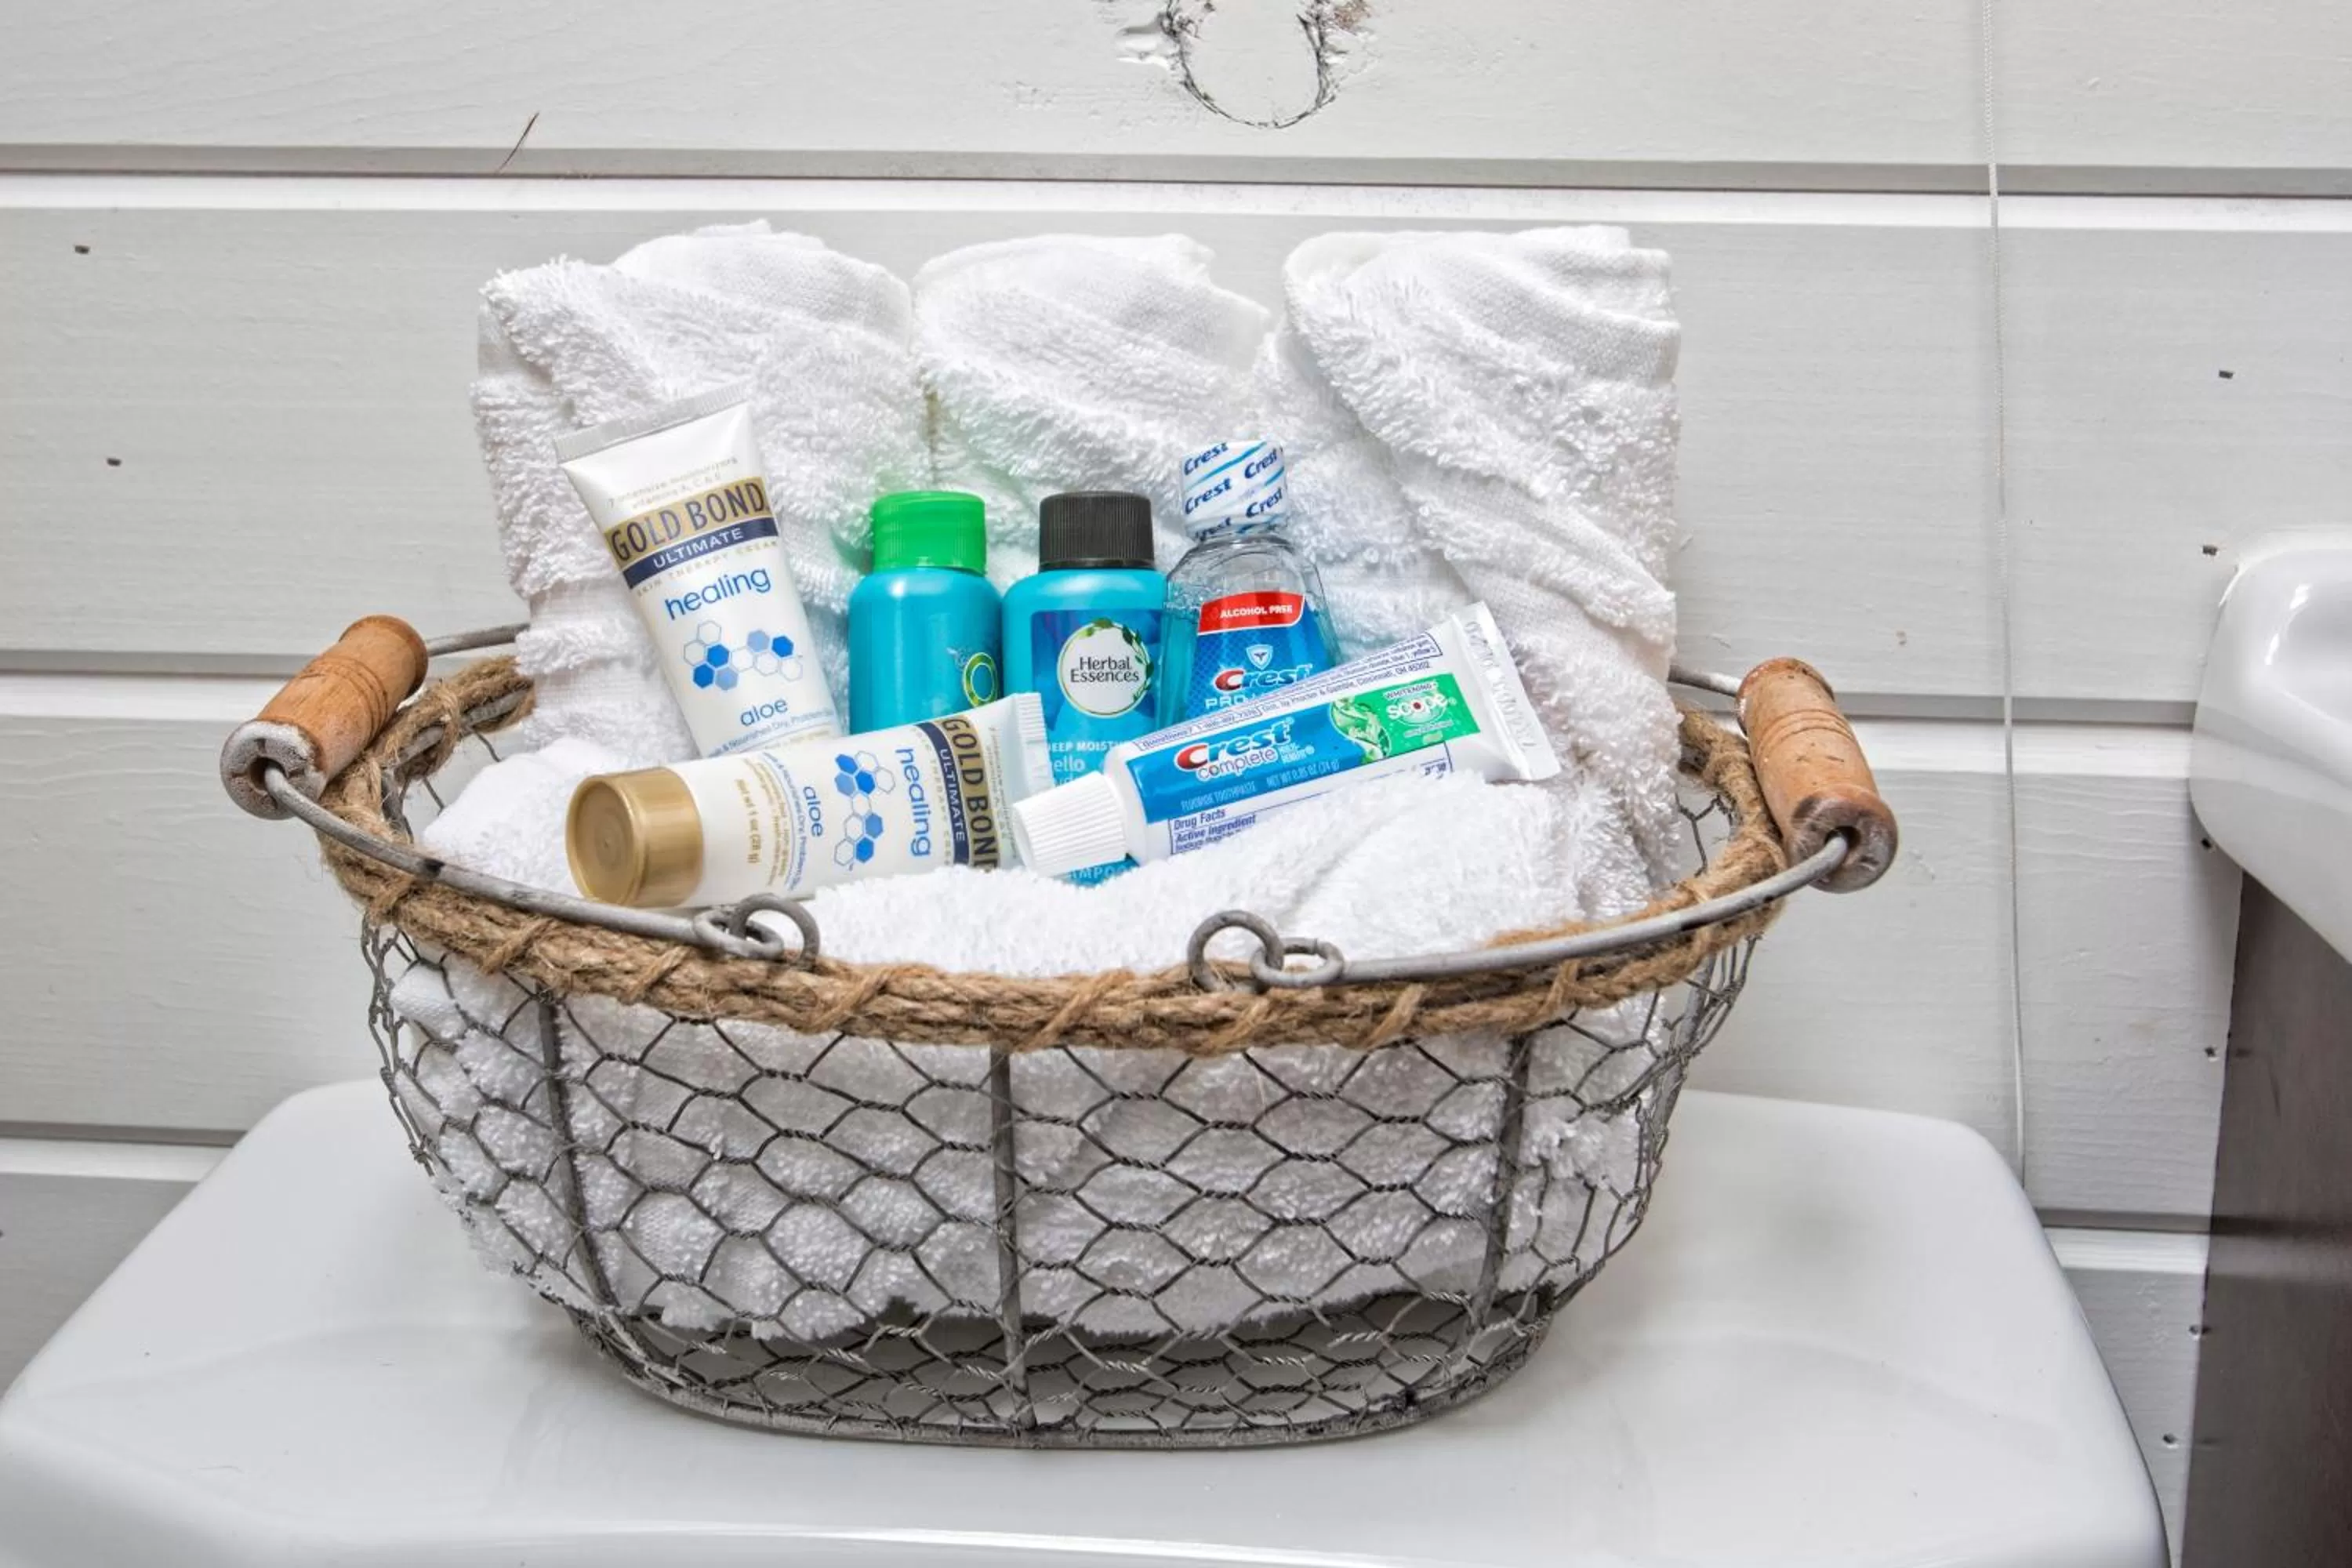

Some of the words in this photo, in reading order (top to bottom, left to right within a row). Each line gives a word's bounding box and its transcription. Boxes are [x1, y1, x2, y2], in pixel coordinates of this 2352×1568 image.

[1184, 442, 1229, 475] Crest
[1244, 448, 1278, 479] Crest
[1185, 478, 1232, 514] Crest
[1246, 487, 1283, 517] Crest
[611, 509, 681, 561] GOLD
[684, 482, 765, 532] BOND
[652, 527, 744, 568] ULTIMATE
[664, 568, 771, 622] healing
[1220, 605, 1268, 619] ALCOHOL
[1270, 604, 1293, 615] FREE
[1070, 668, 1139, 683] Essences
[1079, 655, 1131, 670] Herbal
[1213, 663, 1313, 691] Crest
[1385, 682, 1432, 699] WHITENING
[740, 698, 789, 727] aloe
[942, 719, 985, 785] GOLD
[1048, 742, 1073, 752] EEP
[1076, 740, 1120, 752] MOIST
[1174, 720, 1292, 771] Crest
[1053, 755, 1086, 772] ello
[1197, 746, 1278, 780] complete
[895, 747, 931, 858] healing
[940, 749, 965, 842] ULTIMATE
[803, 786, 823, 837] aloe
[1174, 814, 1197, 830] Drug
[1200, 808, 1226, 824] Facts
[1175, 828, 1207, 843] Active
[1208, 814, 1256, 837] ingredient
